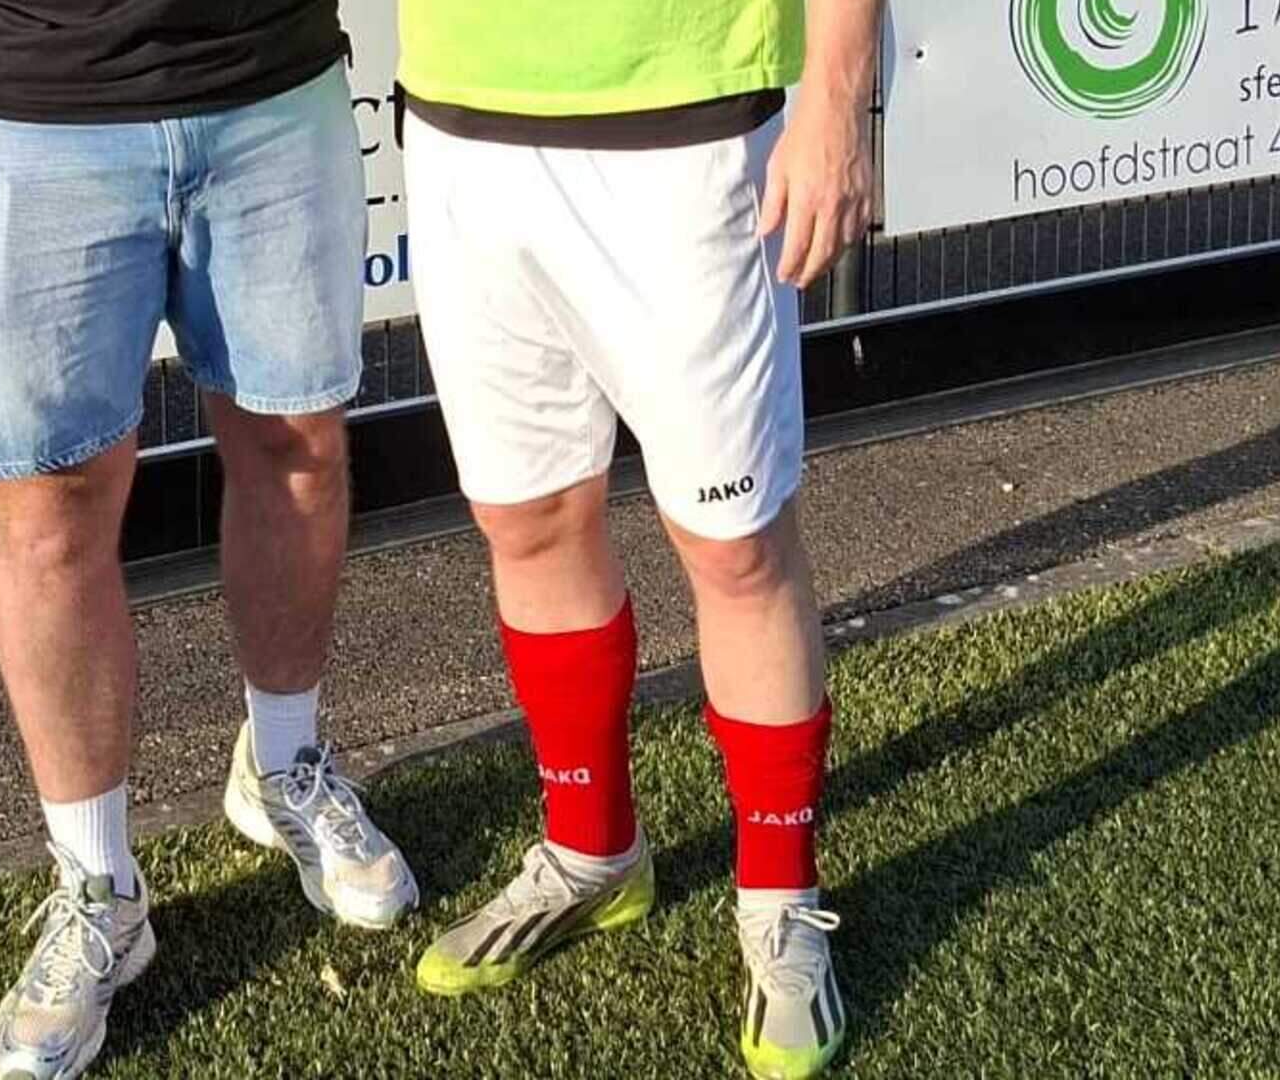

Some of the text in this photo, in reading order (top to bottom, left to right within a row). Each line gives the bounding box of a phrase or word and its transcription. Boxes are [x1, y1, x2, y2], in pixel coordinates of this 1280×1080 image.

[1013, 125, 1255, 203] hoofdstraat
[697, 475, 755, 504] JAKO
[747, 807, 814, 826] JAKO
